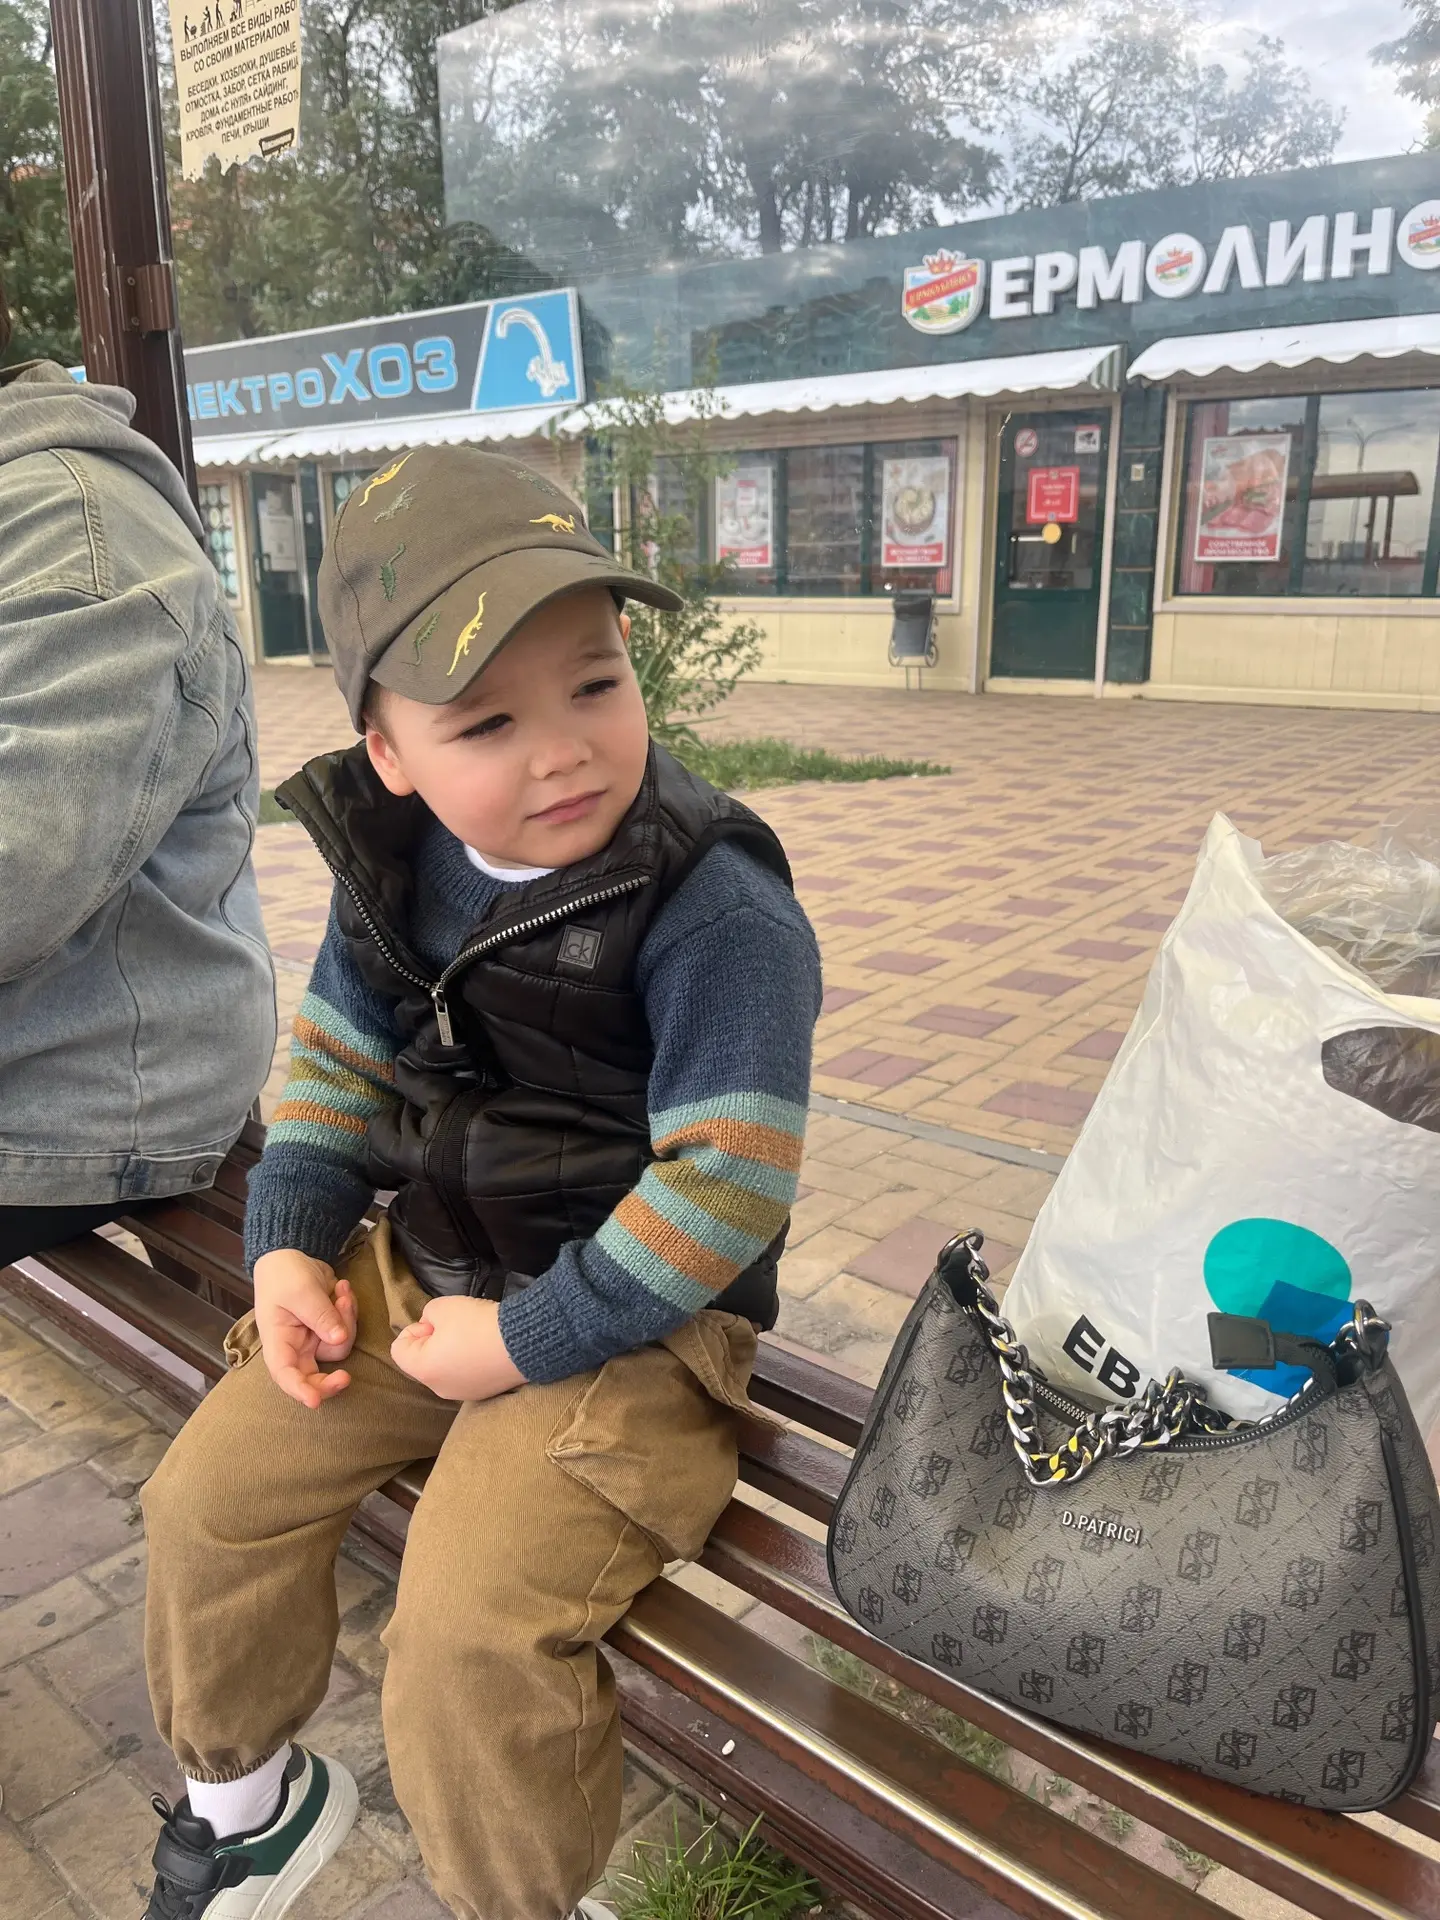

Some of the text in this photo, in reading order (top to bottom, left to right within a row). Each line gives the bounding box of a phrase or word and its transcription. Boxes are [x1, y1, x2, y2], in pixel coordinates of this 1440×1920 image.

[180, 29, 230, 62] ВЫПОЛНЯЕМ
[231, 20, 246, 39] ВСЕ
[248, 9, 273, 31] ВИДЫ
[193, 19, 290, 73] СО СВОИМ МАТЕРИАЛОМ
[259, 40, 297, 69] ДУШЕВЫЕ
[247, 67, 271, 87] СЕТКА
[200, 105, 220, 124] ДОМА
[215, 99, 273, 131] ФУНДАМЕНТНЫЕ
[242, 116, 270, 137] КРЫШИ
[988, 199, 1440, 319] ЕРМОЛИНО
[1062, 1510, 1142, 1545] D.PATRICI
